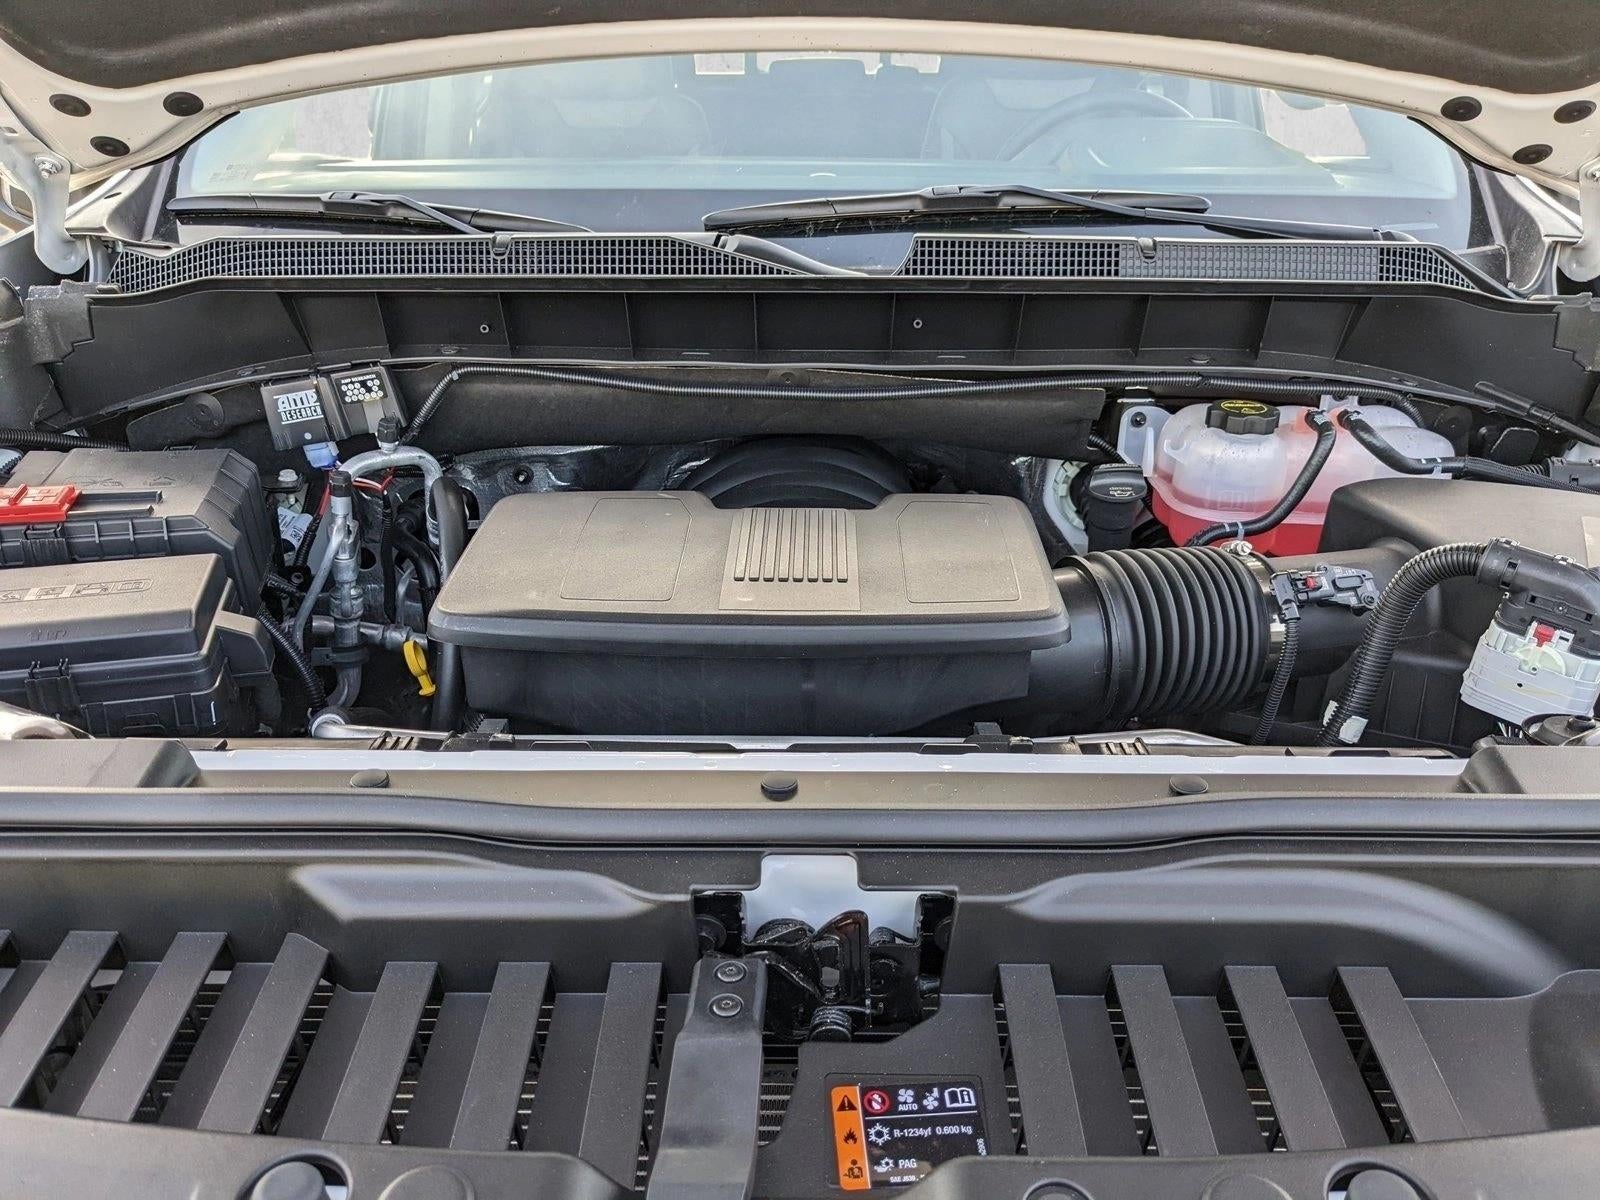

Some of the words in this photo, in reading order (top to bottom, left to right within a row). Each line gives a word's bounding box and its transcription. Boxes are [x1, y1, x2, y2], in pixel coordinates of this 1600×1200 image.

[277, 391, 318, 411] AMP
[280, 404, 323, 422] RESEARCH
[898, 1103, 918, 1112] AUTO
[893, 1127, 932, 1138] R-1234yf
[935, 1125, 960, 1135] 0.600
[960, 1125, 973, 1135] kg
[898, 1158, 917, 1169] PAG
